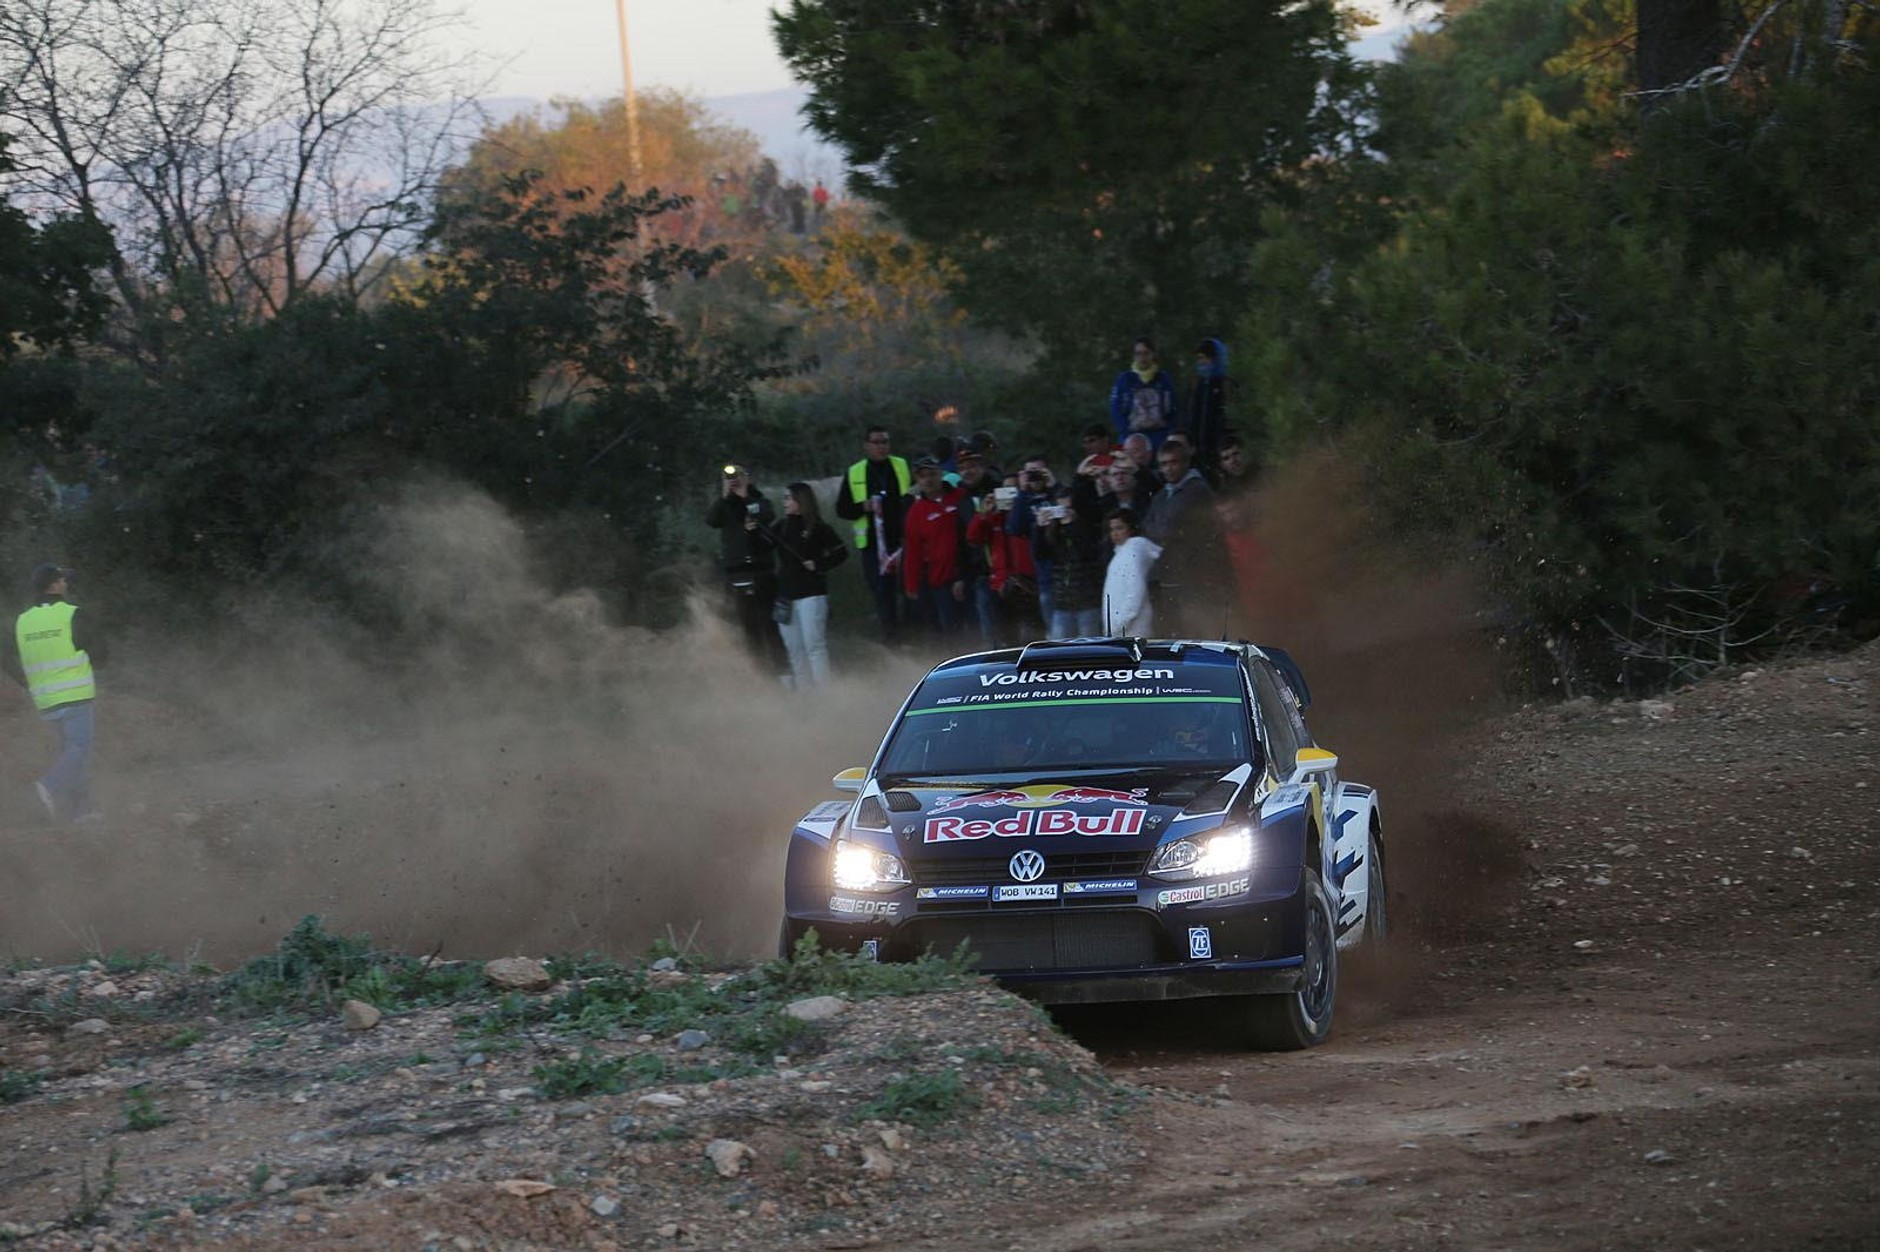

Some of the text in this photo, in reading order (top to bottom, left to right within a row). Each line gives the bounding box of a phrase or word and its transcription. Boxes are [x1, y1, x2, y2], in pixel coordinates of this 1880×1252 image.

[980, 668, 1174, 687] Volkswagen
[994, 692, 1028, 700] World
[1032, 689, 1063, 698] Rally
[1066, 687, 1153, 696] Championship
[924, 808, 1147, 843] Red Bull
[1010, 850, 1045, 882] VW
[937, 887, 988, 895] MICHELIN
[1001, 888, 1019, 897] WOB
[1084, 881, 1136, 890] MICHELIN
[1169, 879, 1250, 903] Castrol EDGE
[854, 900, 901, 915] EDGE
[1193, 935, 1208, 951] ZF
